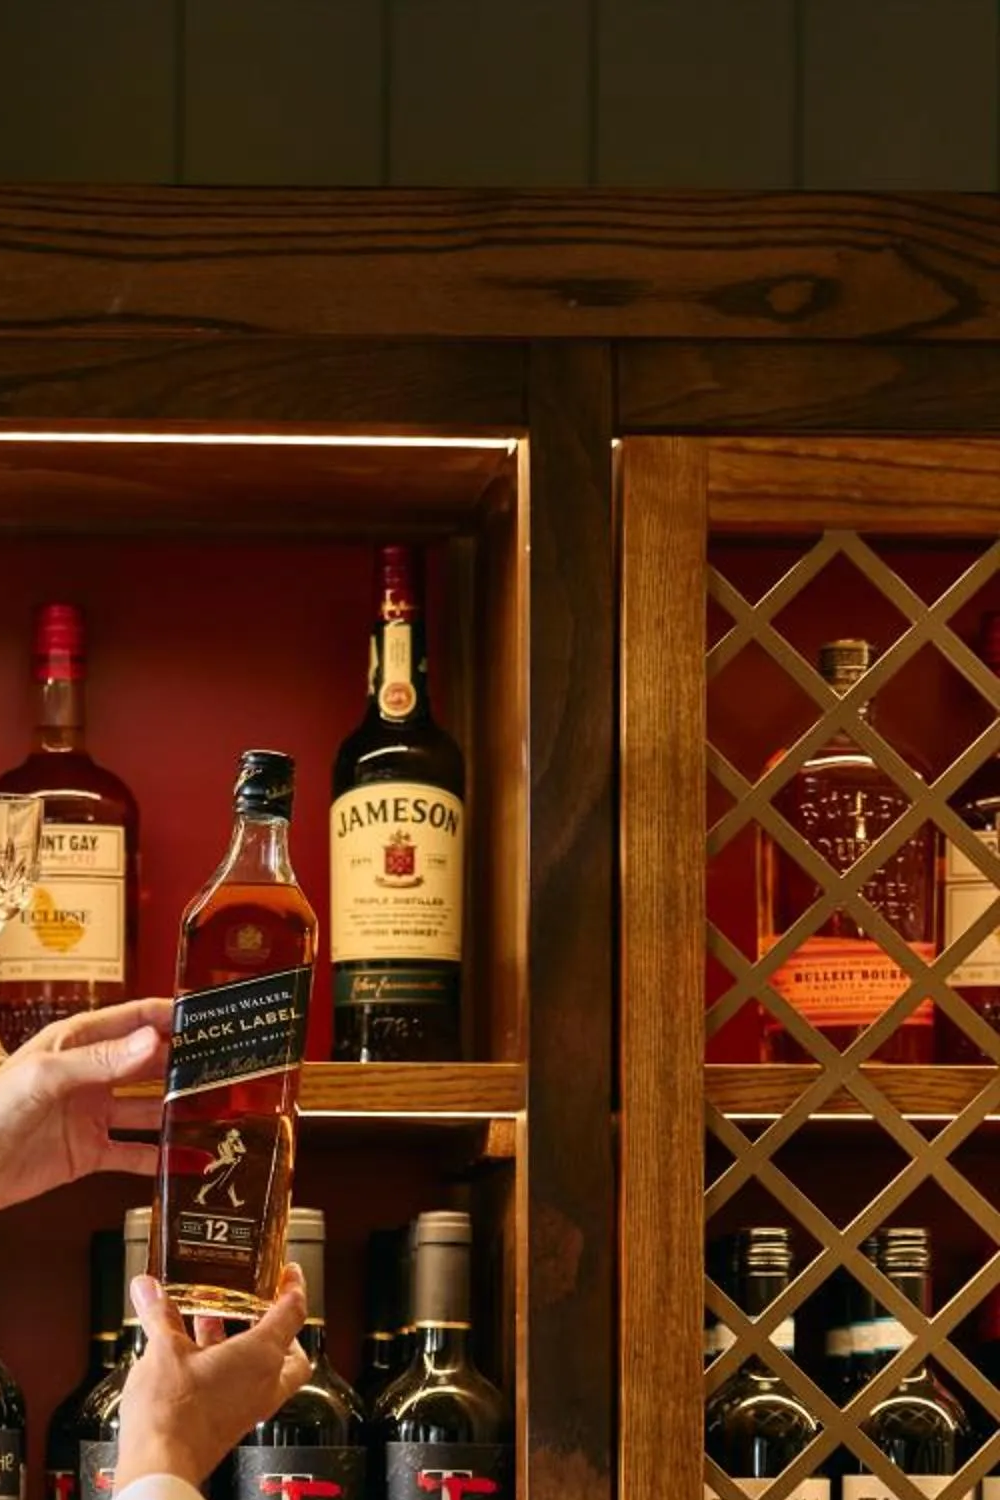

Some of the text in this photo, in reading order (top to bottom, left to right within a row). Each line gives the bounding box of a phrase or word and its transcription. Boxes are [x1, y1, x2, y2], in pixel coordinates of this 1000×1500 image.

[337, 797, 460, 838] JAMESON
[69, 835, 98, 851] GAY
[20, 910, 91, 924] ECLIPSE
[794, 970, 856, 983] BULLEIT
[183, 990, 290, 1027] JOHNNIE WALKER
[171, 1006, 300, 1049] BLACK LABEL
[205, 1219, 230, 1242] 12
